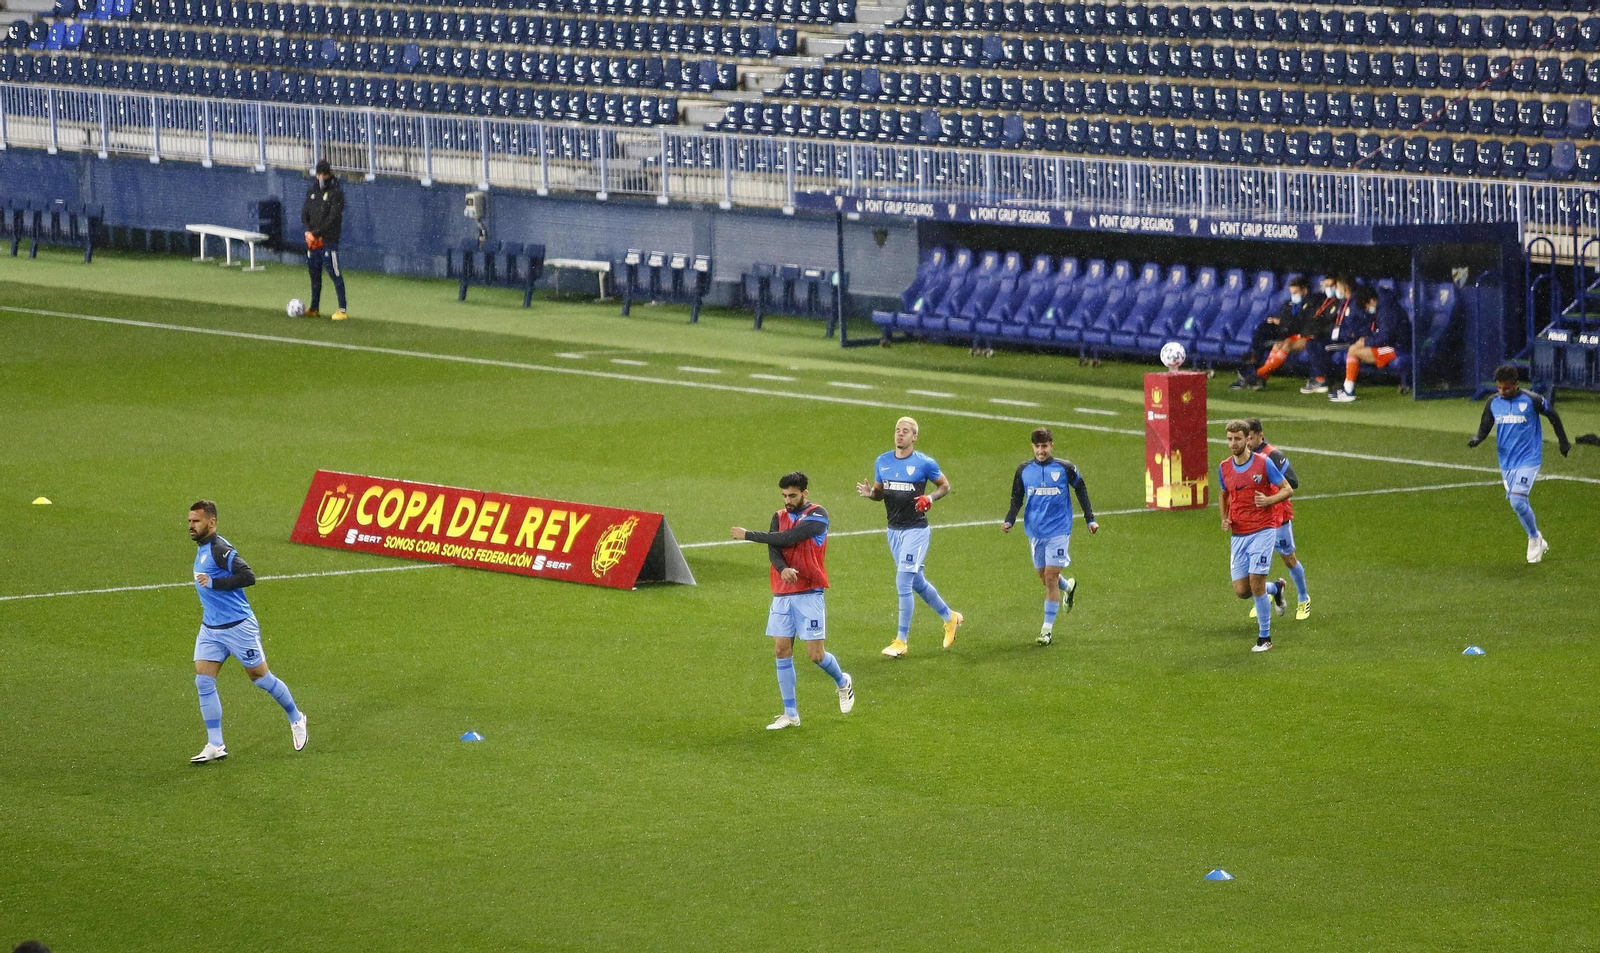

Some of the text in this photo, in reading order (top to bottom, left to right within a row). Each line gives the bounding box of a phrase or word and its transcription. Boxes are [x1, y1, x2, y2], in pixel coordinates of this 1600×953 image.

[864, 199, 934, 217] PONT GRUP SEGUROS
[978, 207, 1051, 224] PONT GRUP SEGUROS
[1099, 214, 1175, 232] PONT GRUP SEGUROS
[1219, 221, 1299, 239] PONT GRUP SEGUROS
[356, 485, 445, 535] COPA
[446, 496, 511, 545] DEL
[514, 506, 592, 554] REY
[357, 534, 383, 544] SEAT
[383, 535, 533, 568] SOMOS COPA SOMOS FEDERACIÓN
[545, 560, 572, 570] SEAT
